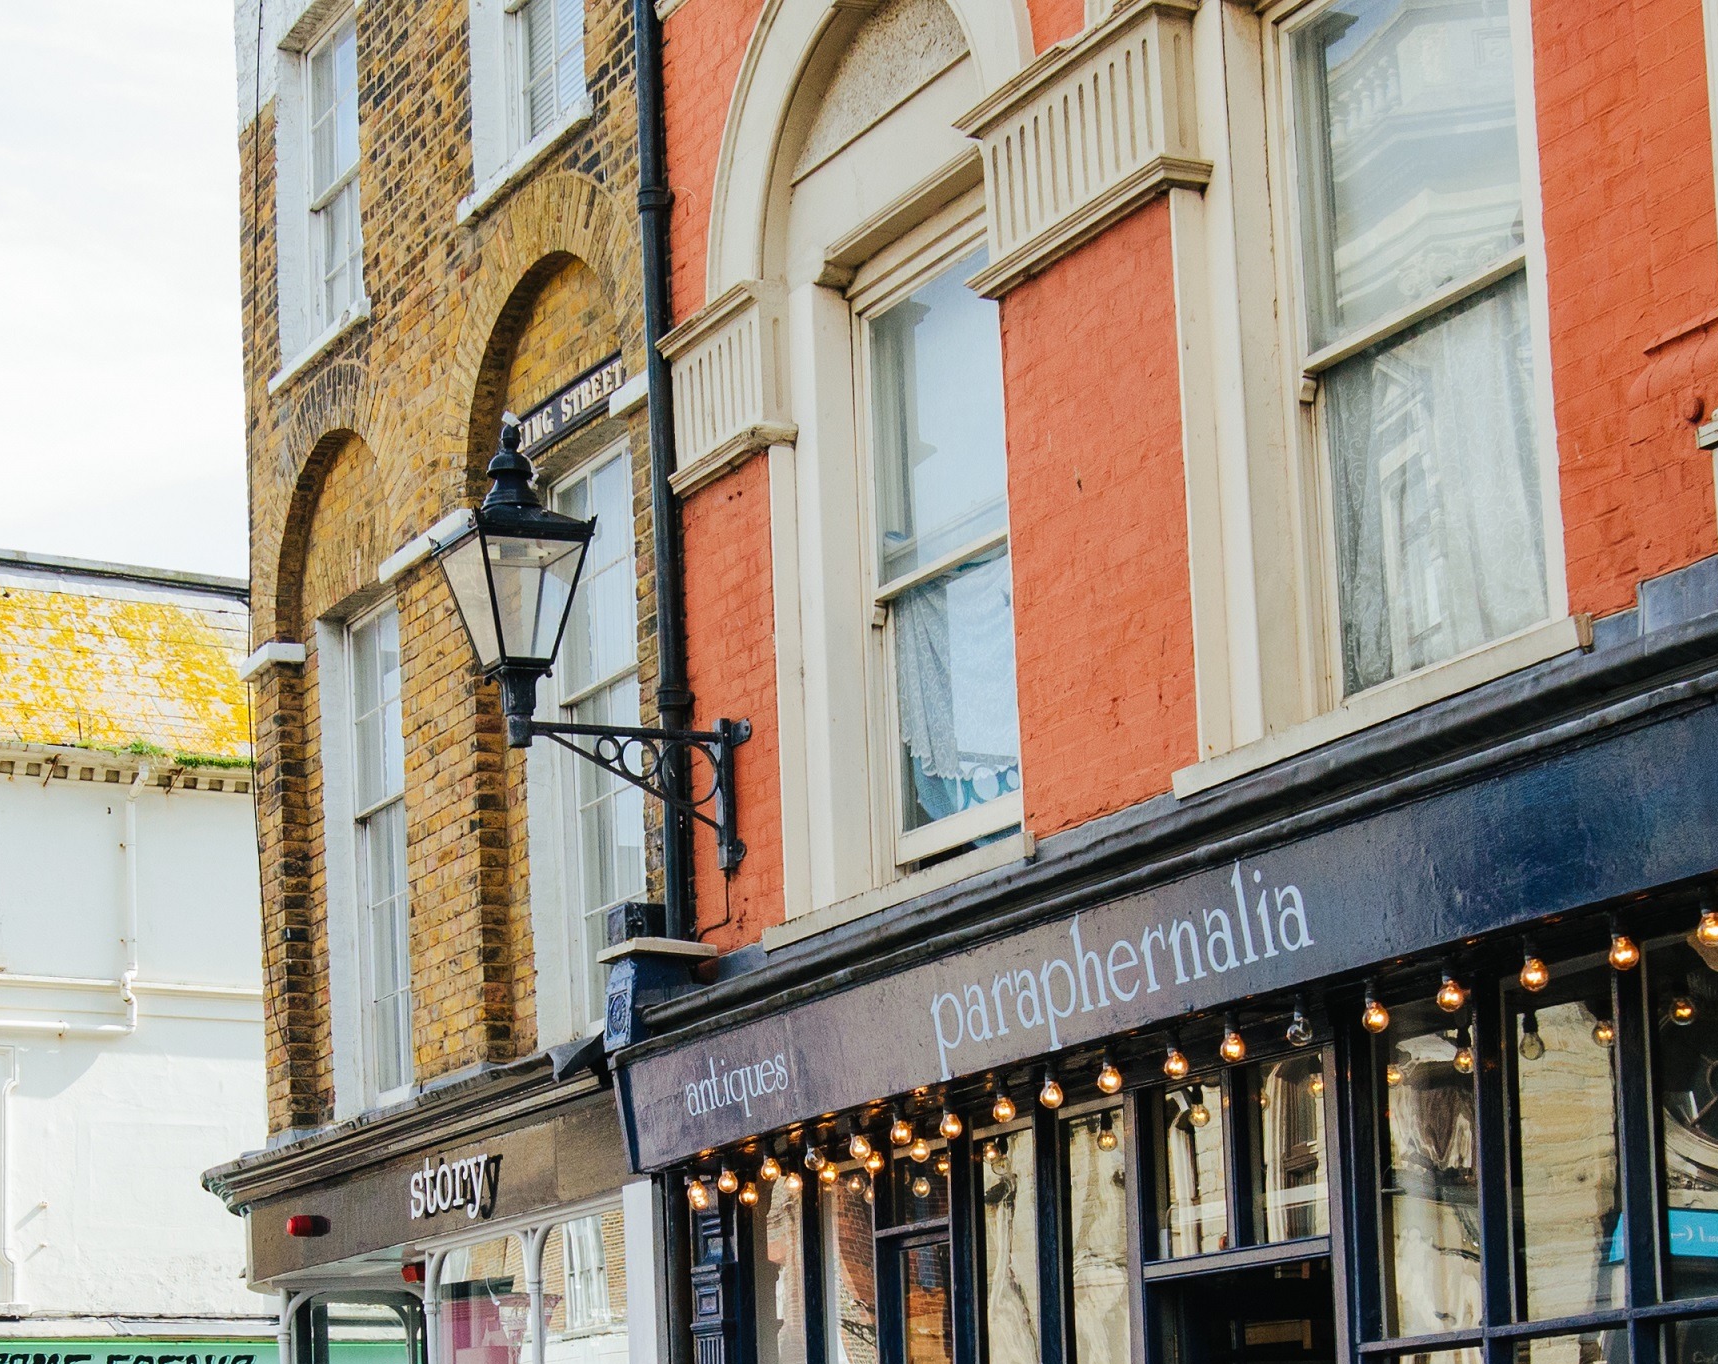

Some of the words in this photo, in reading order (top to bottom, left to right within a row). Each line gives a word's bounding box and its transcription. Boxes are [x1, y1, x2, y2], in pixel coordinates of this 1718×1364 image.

[560, 359, 623, 423] STREET
[930, 860, 1315, 1082] paraphernalia
[685, 1052, 789, 1118] antiques
[410, 1153, 488, 1220] story
